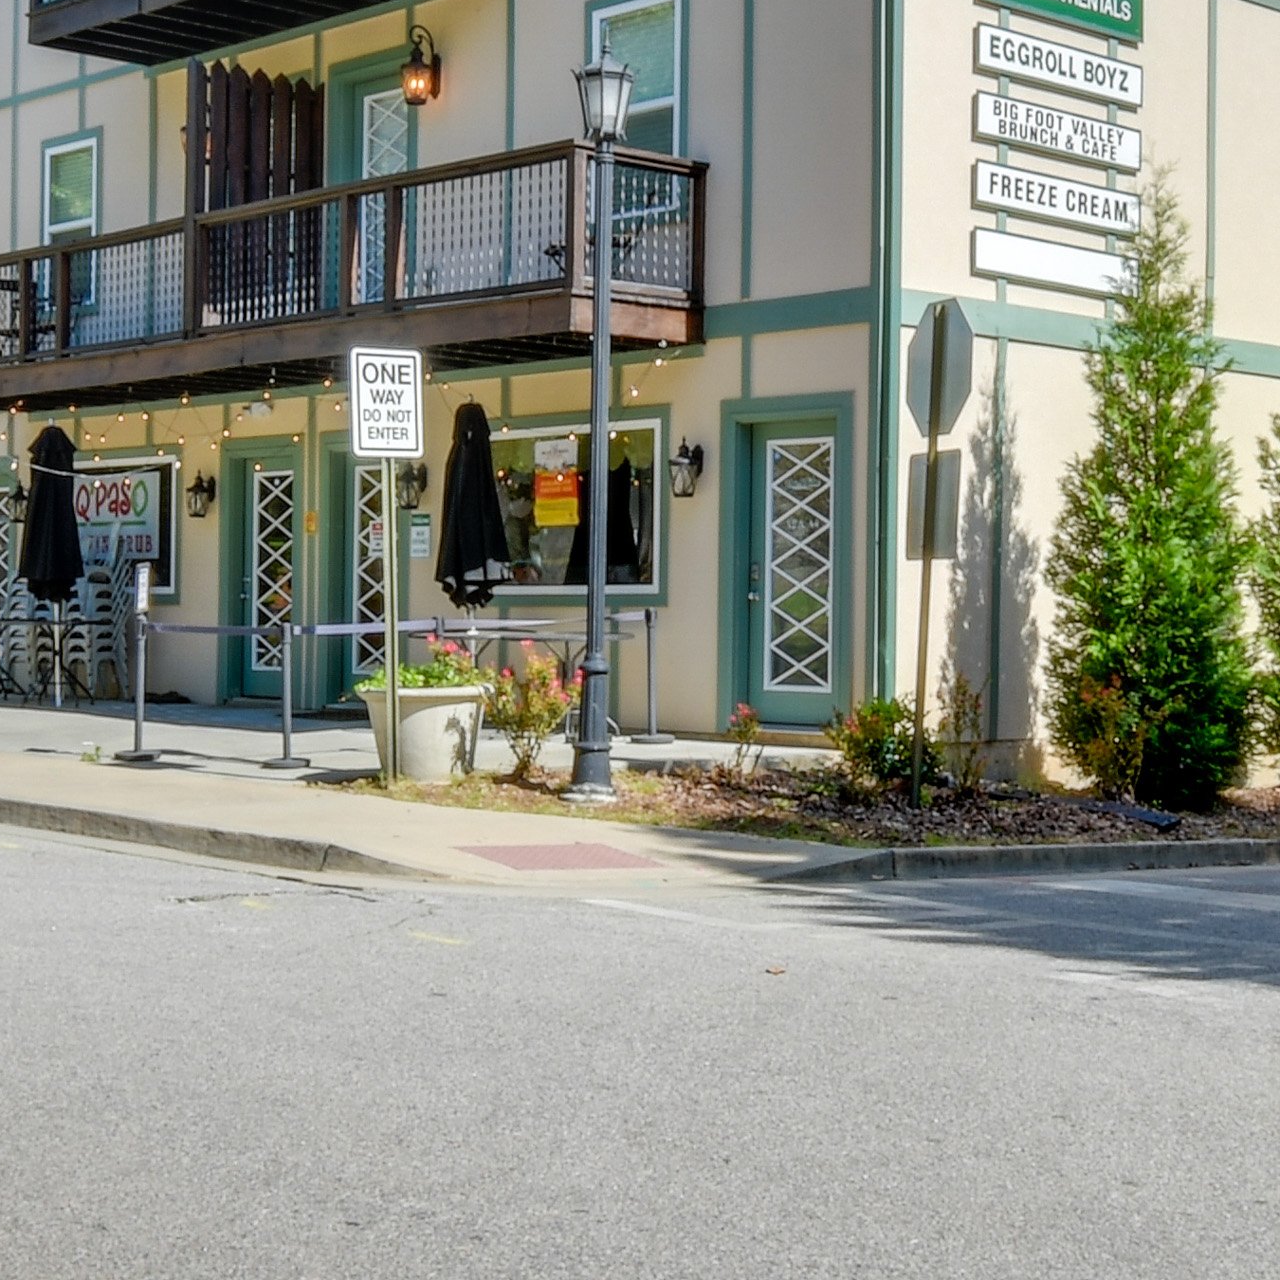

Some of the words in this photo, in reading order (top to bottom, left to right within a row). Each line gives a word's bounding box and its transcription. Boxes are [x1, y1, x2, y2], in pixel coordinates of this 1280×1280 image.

[990, 35, 1077, 79] EGGROLL
[1084, 60, 1129, 93] BOYZ
[993, 100, 1018, 120] BIG
[1026, 107, 1064, 132] FOOT
[1072, 119, 1124, 146] VALLEY
[998, 119, 1059, 147] BRUNCH
[1065, 135, 1074, 151] &
[1082, 138, 1117, 161] CAFE
[990, 172, 1058, 208] FREEZE
[1066, 189, 1128, 223] CREAM
[362, 362, 411, 385] ONE
[370, 388, 404, 405] WAY
[363, 408, 381, 422] DO
[387, 409, 412, 423] NOT
[368, 426, 409, 440] ENTER
